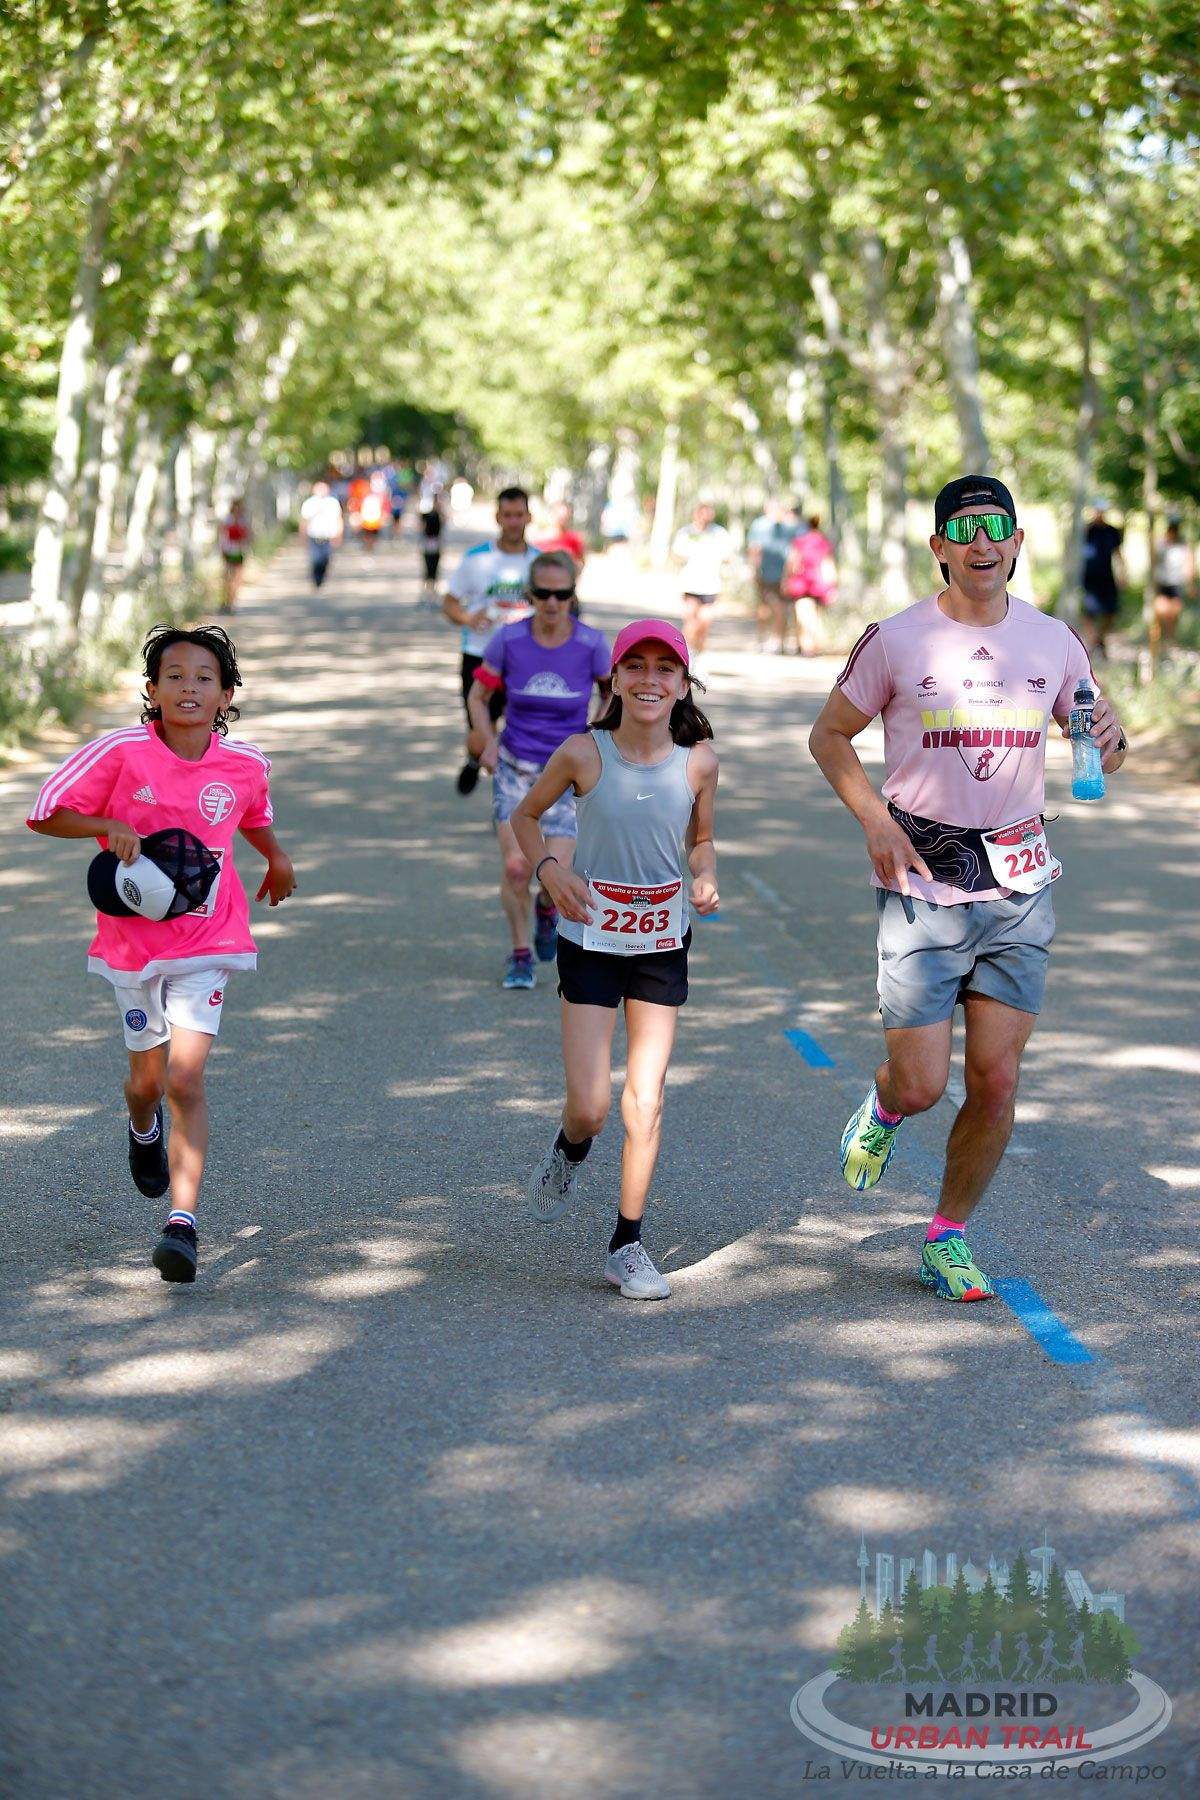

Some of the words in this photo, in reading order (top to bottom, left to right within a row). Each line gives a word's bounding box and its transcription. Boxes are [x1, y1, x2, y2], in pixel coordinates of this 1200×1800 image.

[976, 680, 1004, 688] ZURICH
[132, 793, 157, 806] adidas
[1004, 843, 1048, 879] 226
[606, 886, 626, 894] Vuelta
[662, 885, 678, 894] Campo
[600, 909, 670, 934] 2263
